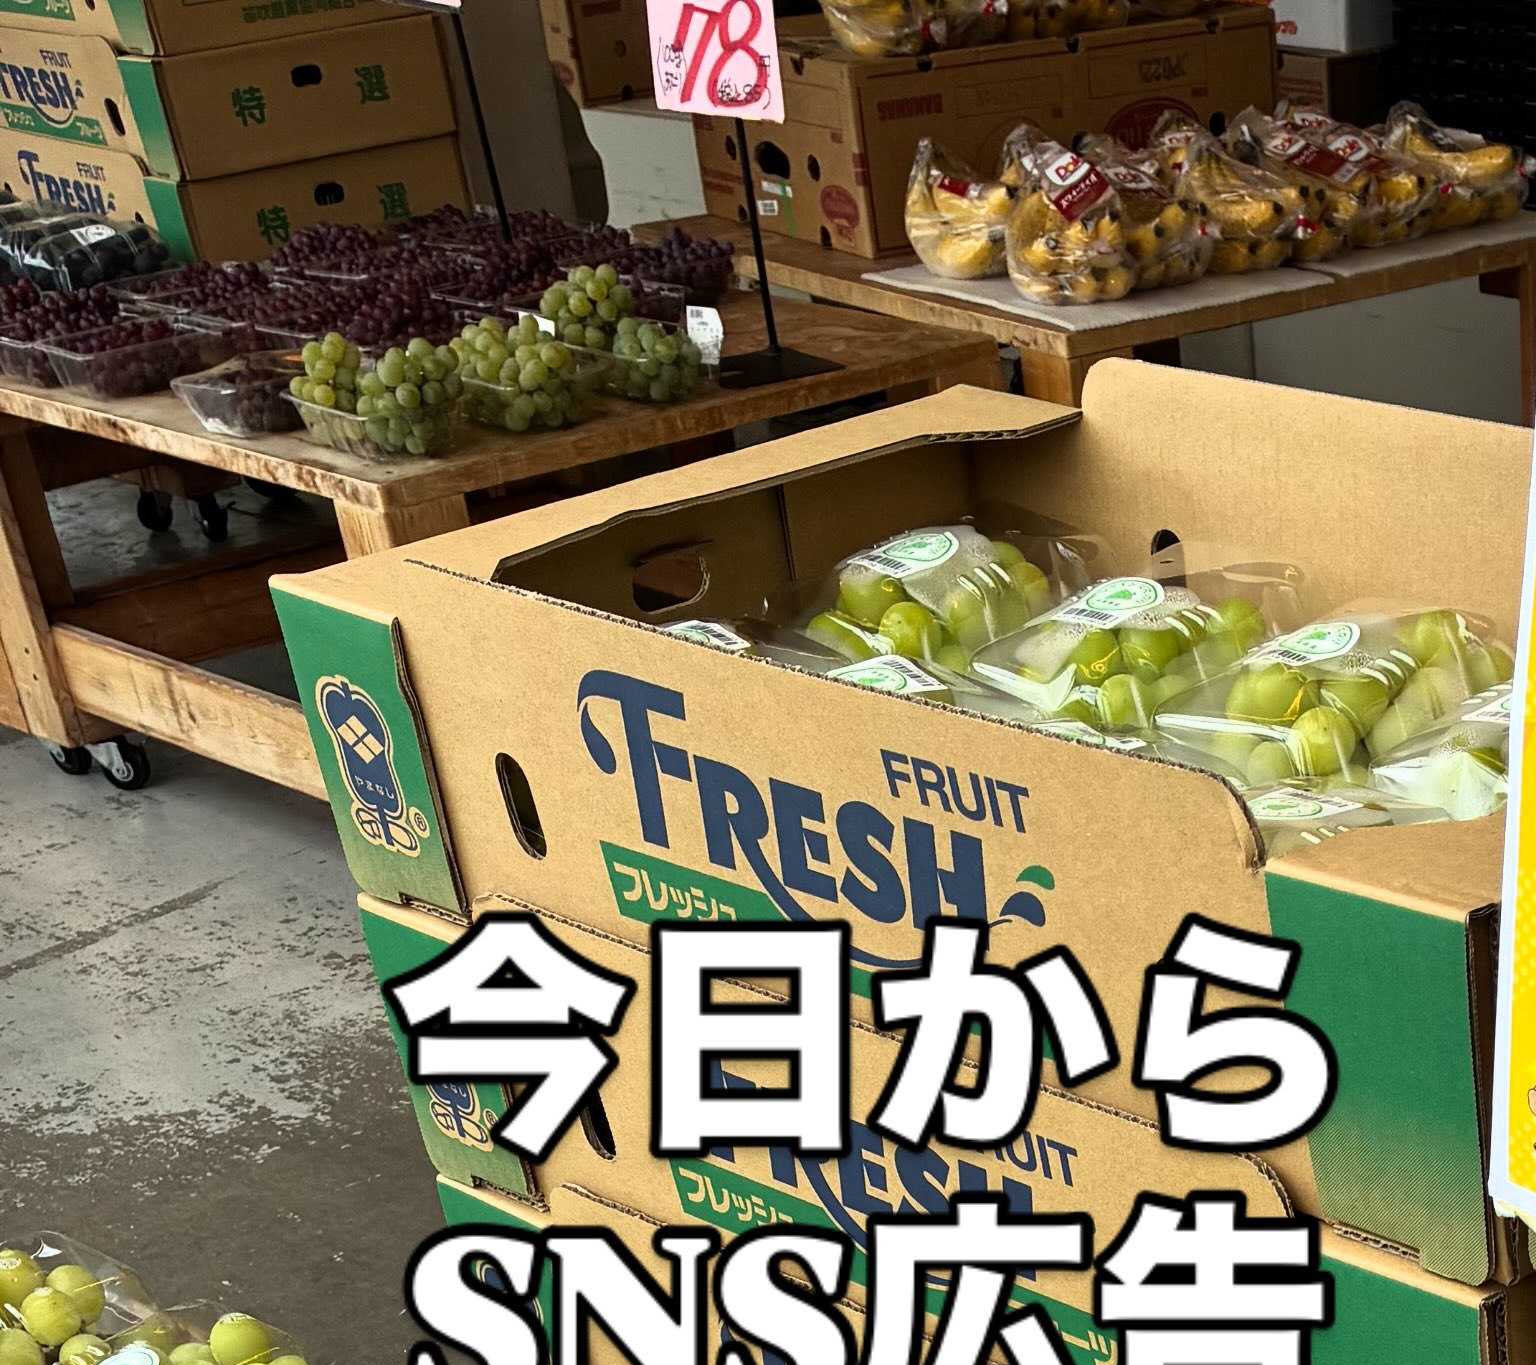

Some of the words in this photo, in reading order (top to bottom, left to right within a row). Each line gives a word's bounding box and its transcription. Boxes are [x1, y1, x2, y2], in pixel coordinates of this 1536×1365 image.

[39, 49, 72, 69] FRUIT
[76, 161, 107, 182] FRUIT
[576, 669, 994, 952] FRESH
[880, 748, 1031, 835] FRUIT
